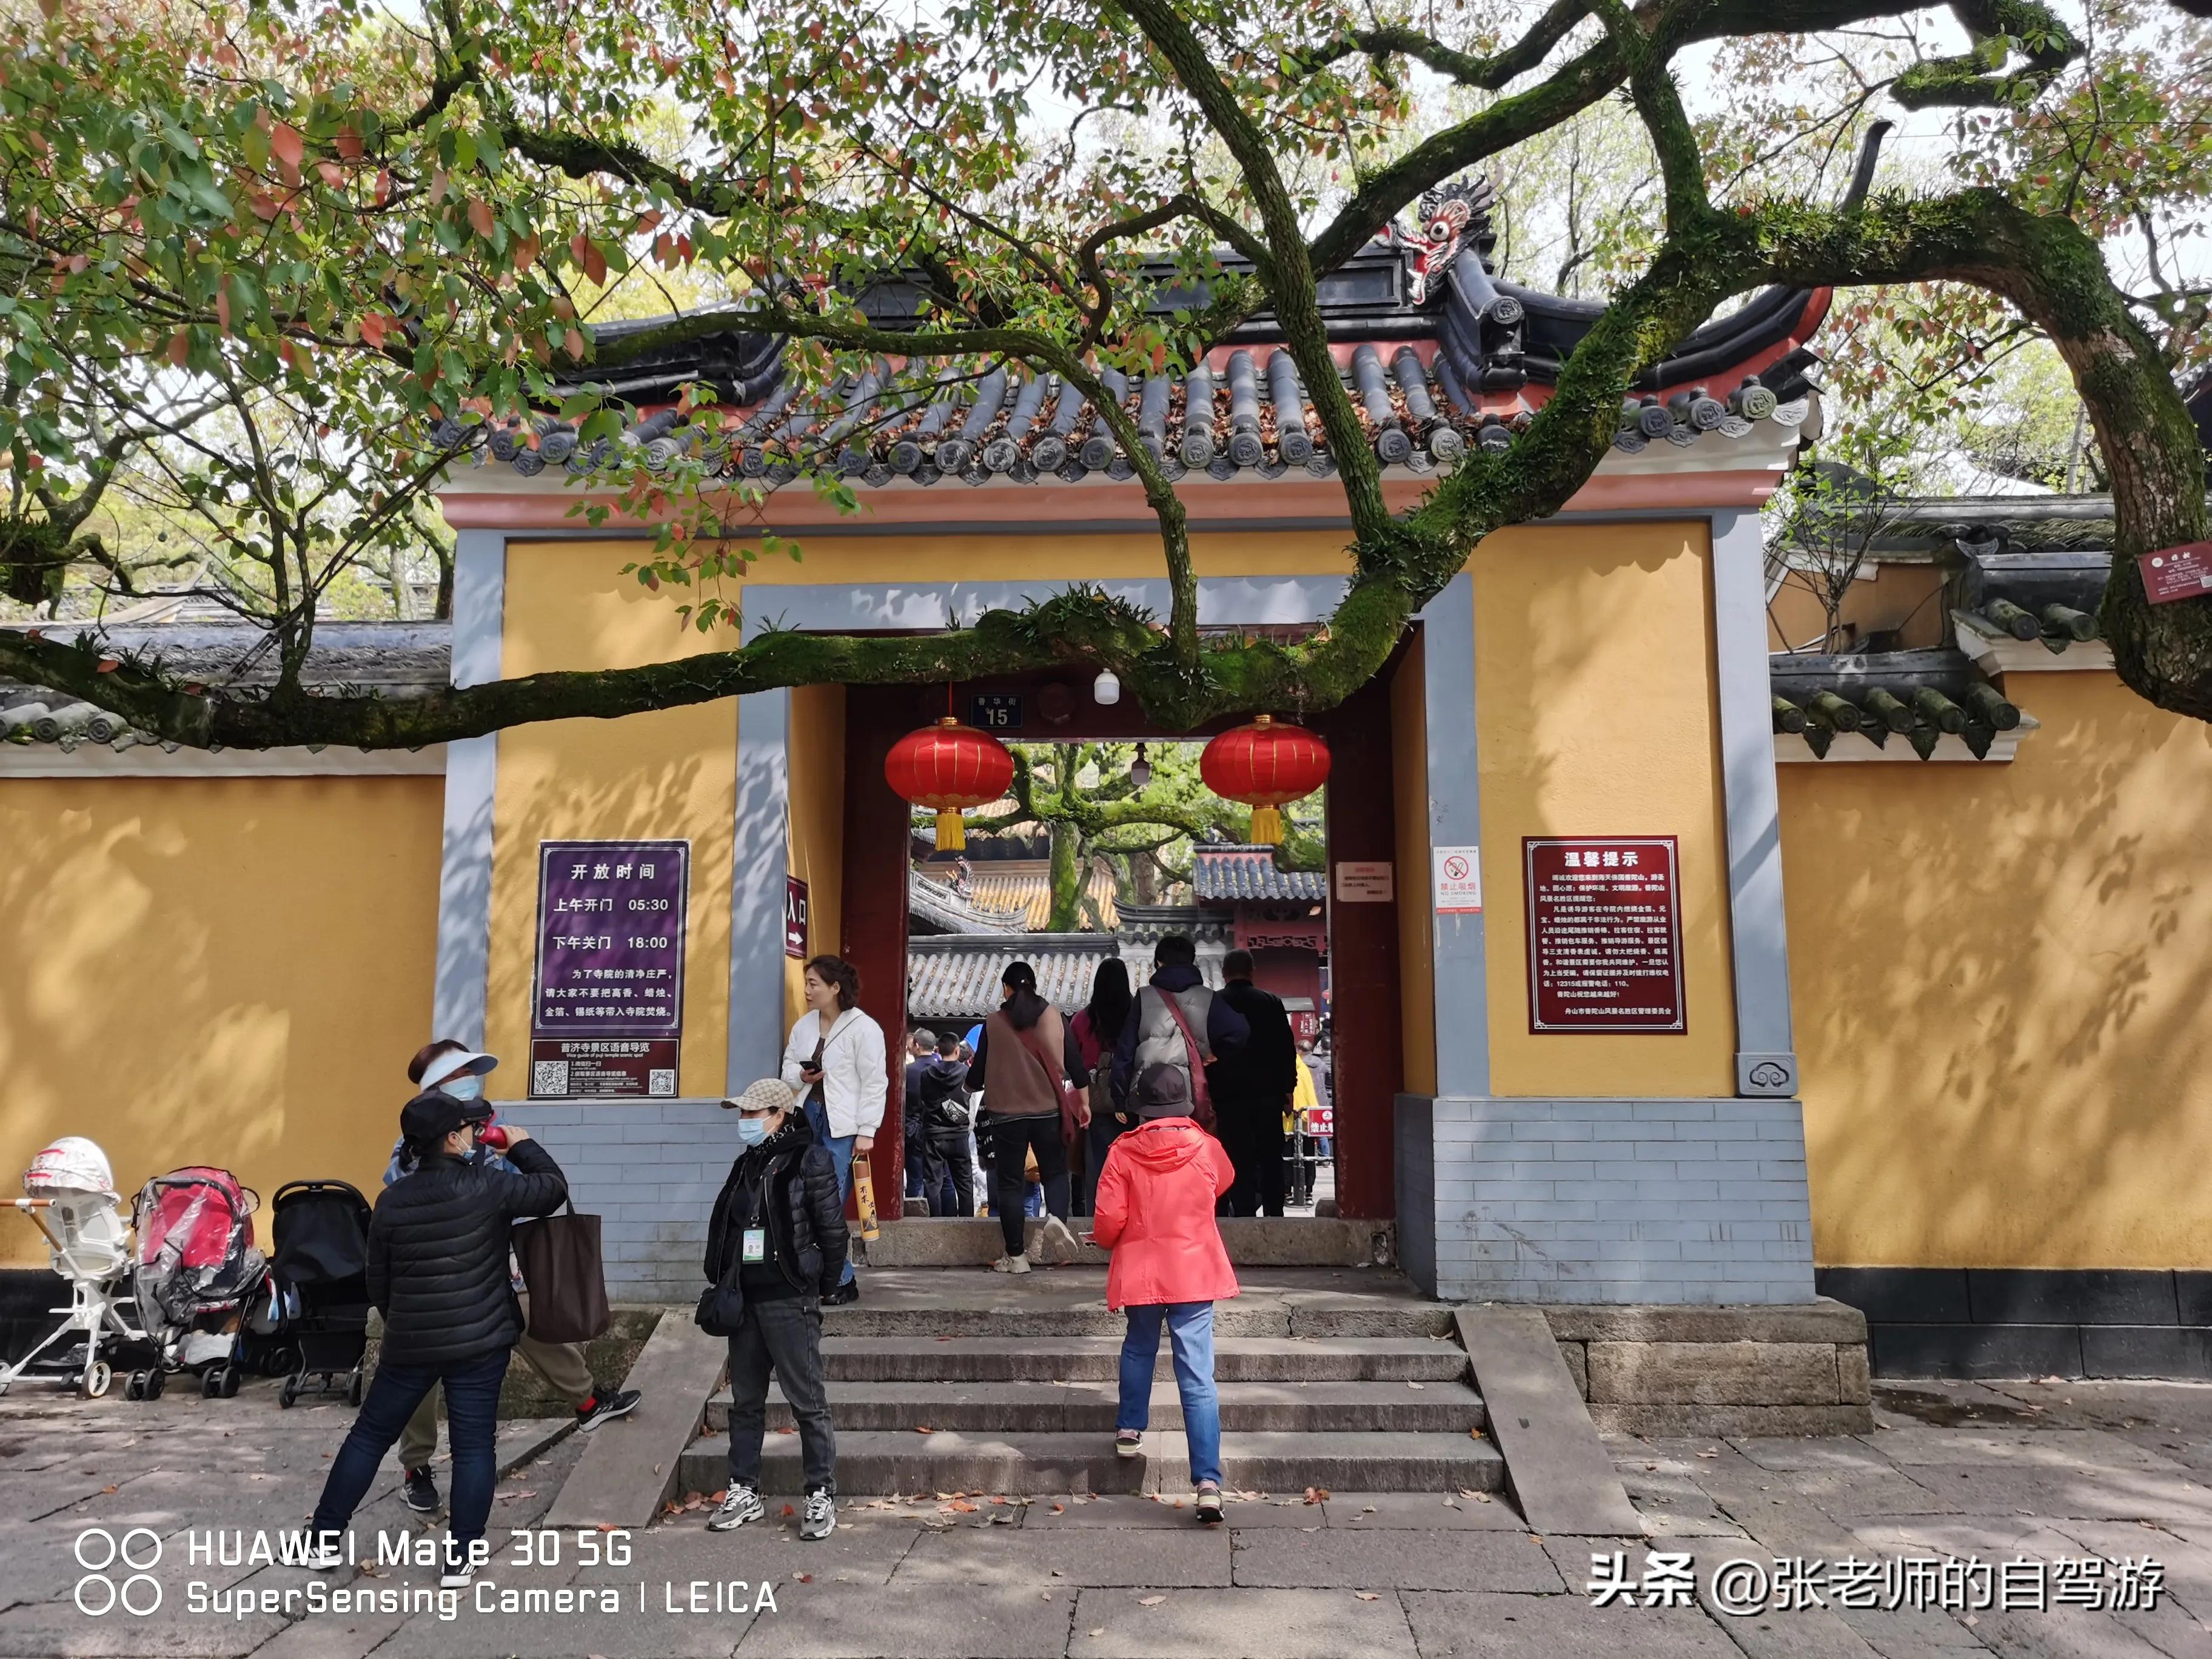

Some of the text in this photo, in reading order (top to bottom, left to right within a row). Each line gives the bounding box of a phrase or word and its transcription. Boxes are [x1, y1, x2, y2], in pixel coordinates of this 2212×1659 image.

[988, 709, 1008, 725] 15
[1564, 851, 1638, 867] 温馨提示
[571, 863, 655, 880] 开放时间
[1441, 882, 1476, 891] 禁止吸烟
[553, 898, 668, 912] 上午开门 05:30
[787, 891, 806, 926] 入口
[552, 936, 668, 950] 下午关门 18:00
[561, 1042, 650, 1053] 普济寺景区语音导览
